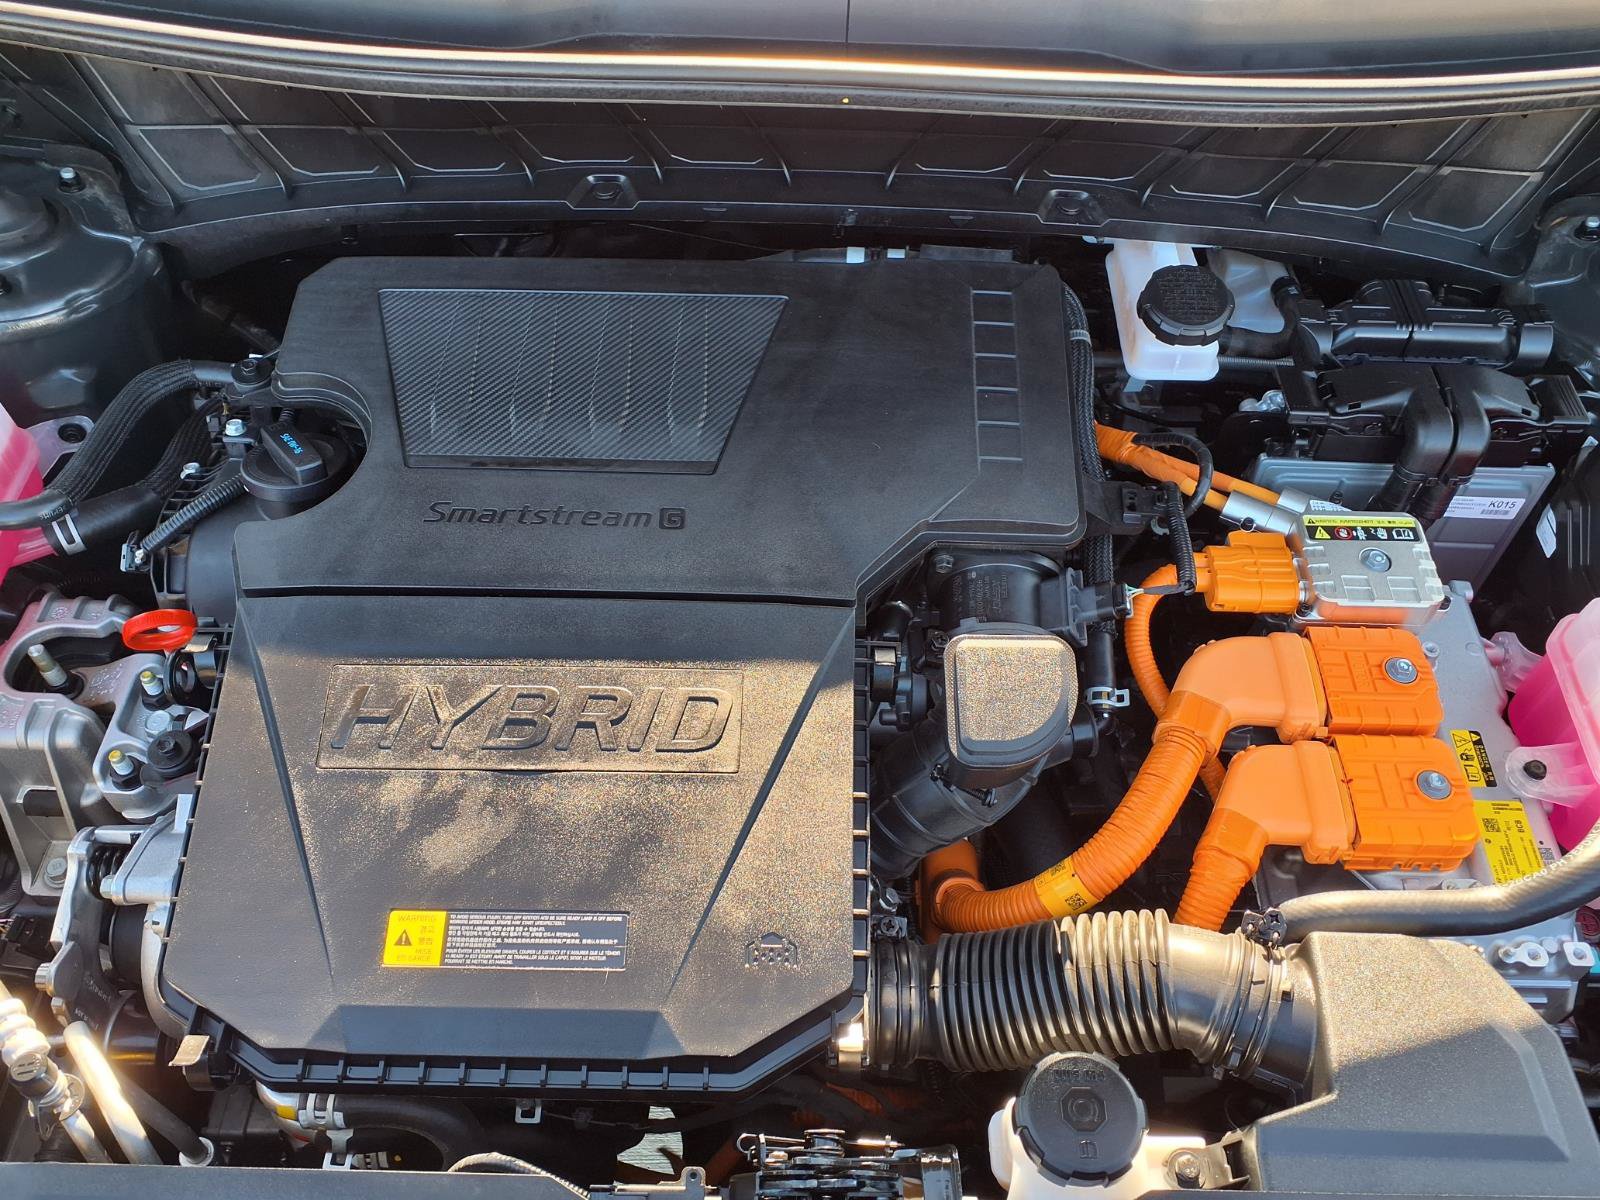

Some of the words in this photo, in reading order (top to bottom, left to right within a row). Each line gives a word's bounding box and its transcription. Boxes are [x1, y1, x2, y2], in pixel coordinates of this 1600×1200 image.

[423, 501, 652, 527] Smartstream
[1488, 500, 1516, 508] K015
[330, 684, 735, 754] HYBRID
